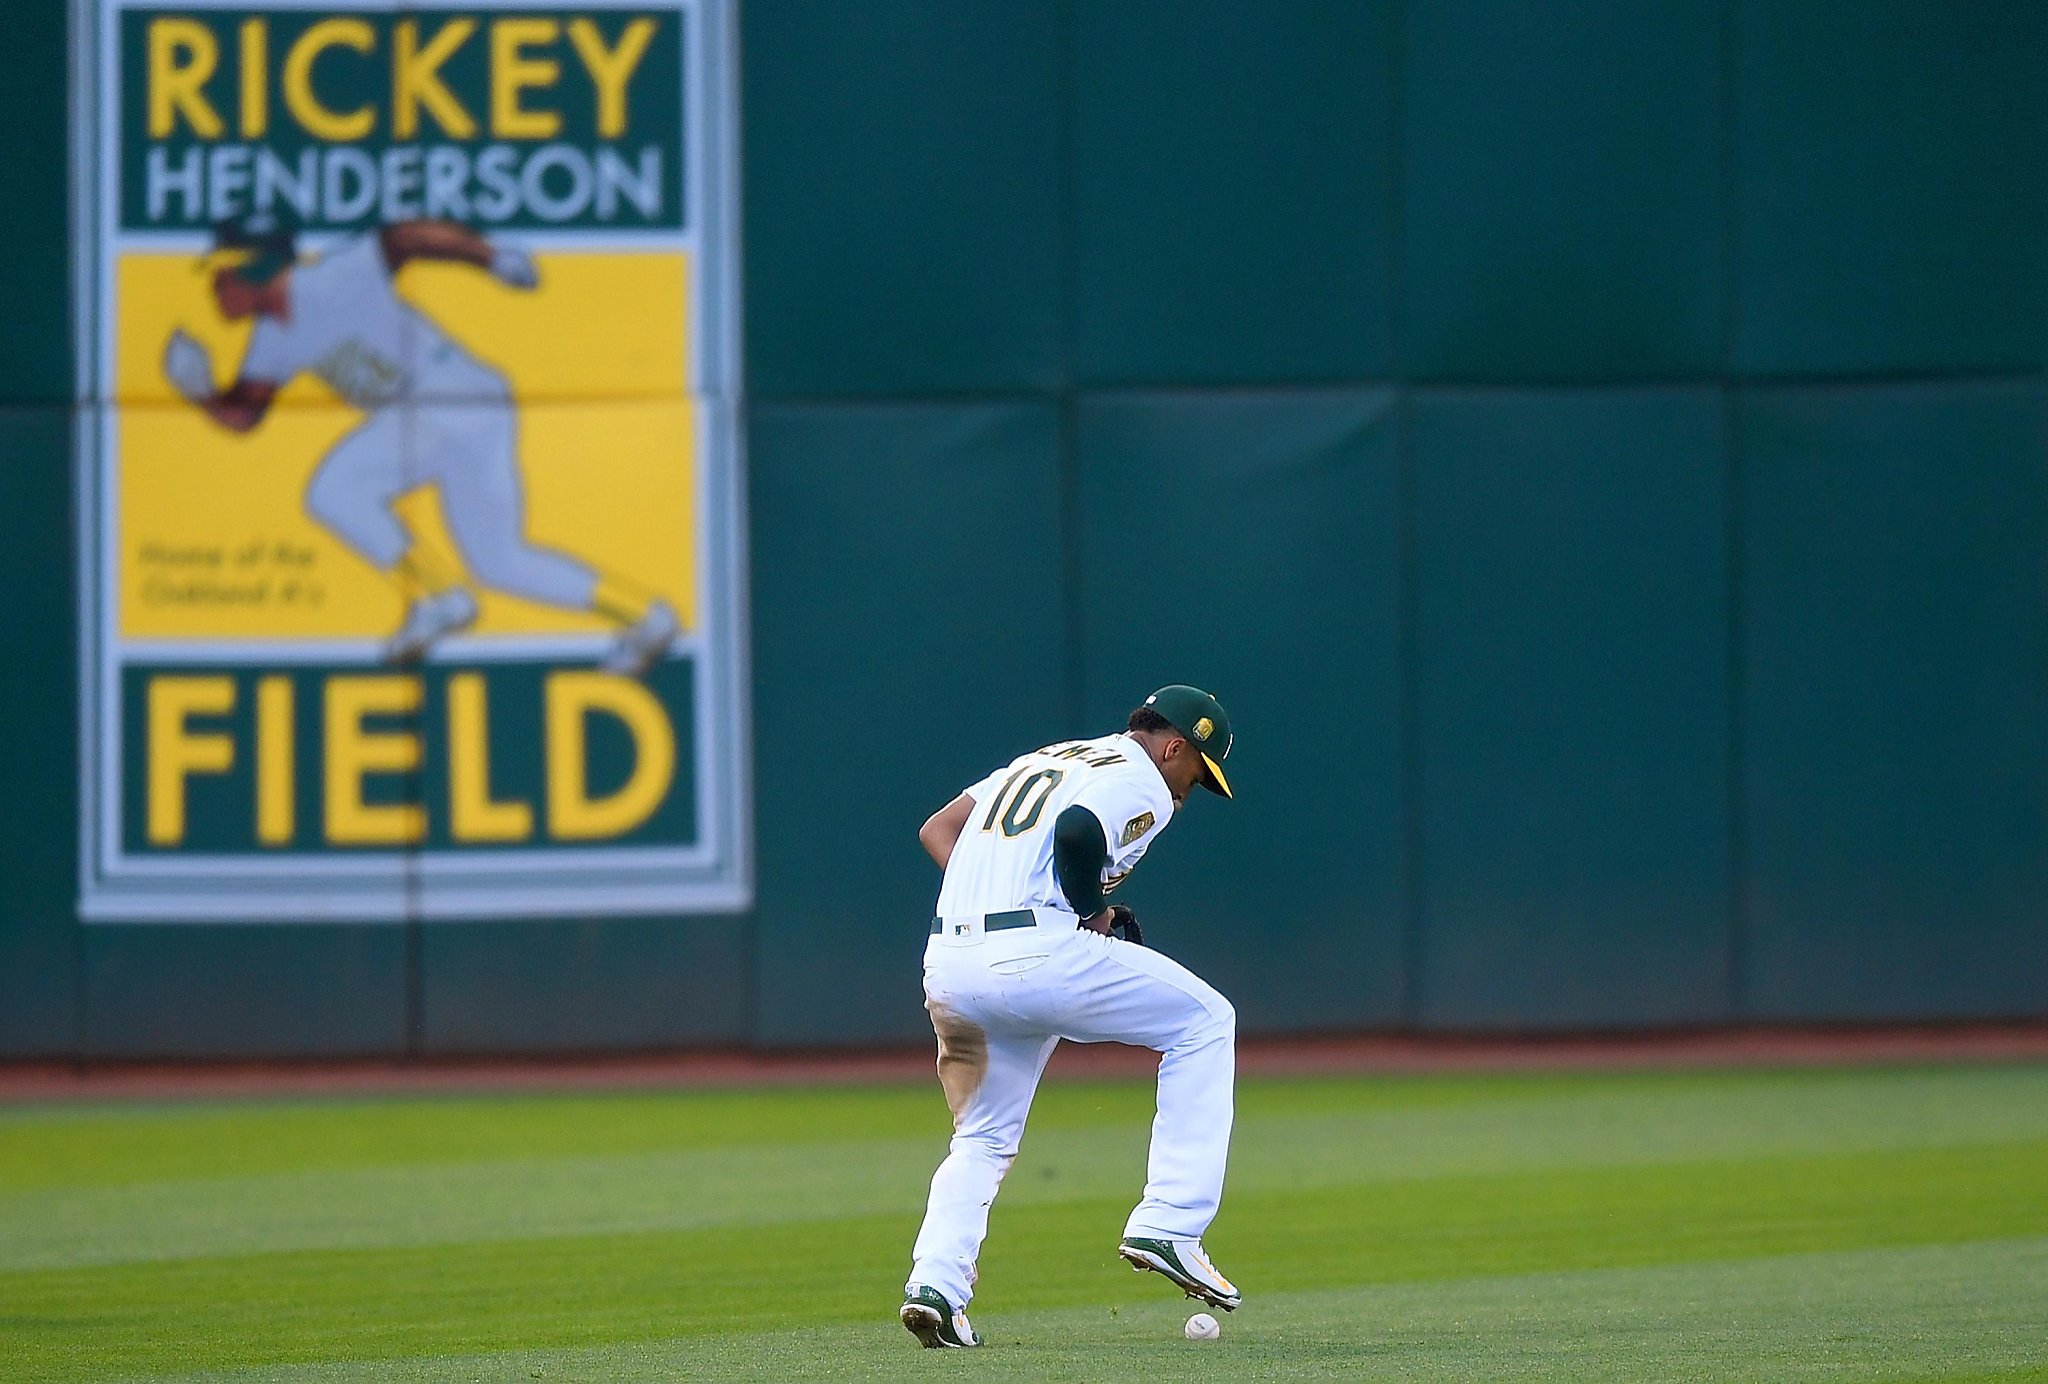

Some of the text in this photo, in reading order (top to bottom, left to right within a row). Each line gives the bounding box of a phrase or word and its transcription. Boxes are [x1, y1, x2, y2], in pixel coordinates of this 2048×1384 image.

[147, 18, 657, 140] RICKEY
[146, 145, 663, 221] HENDERSON
[147, 671, 676, 846] FIELD
[979, 764, 1066, 840] 10
